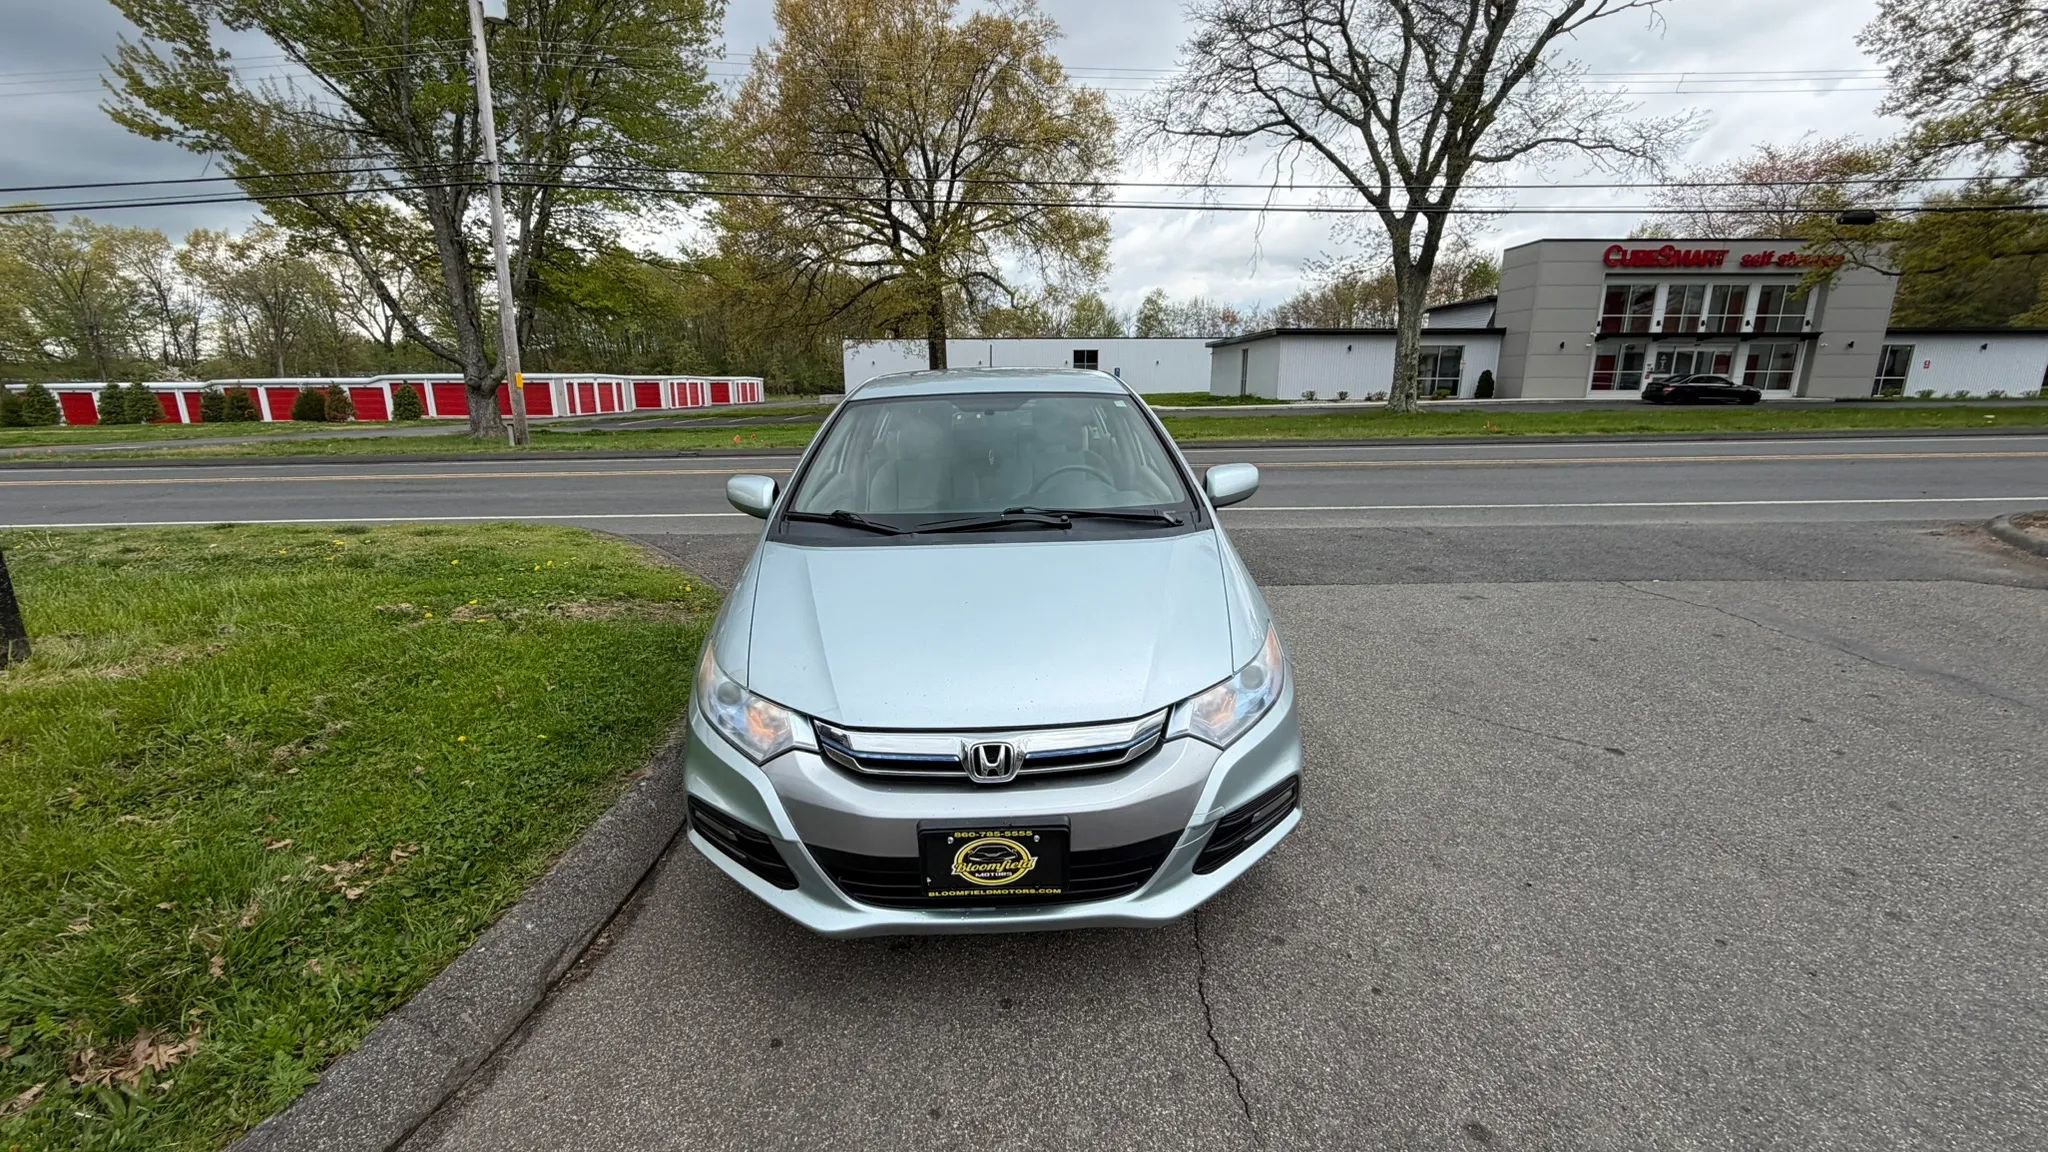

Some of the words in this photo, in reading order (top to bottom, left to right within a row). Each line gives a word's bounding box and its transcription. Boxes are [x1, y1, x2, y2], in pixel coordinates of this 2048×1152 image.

[1740, 250, 1775, 267] self
[954, 830, 1033, 838] 860-785-5555
[954, 858, 1035, 873] Bloomfield
[928, 888, 1062, 897] BLOOMFIELDMOTORS.COM
